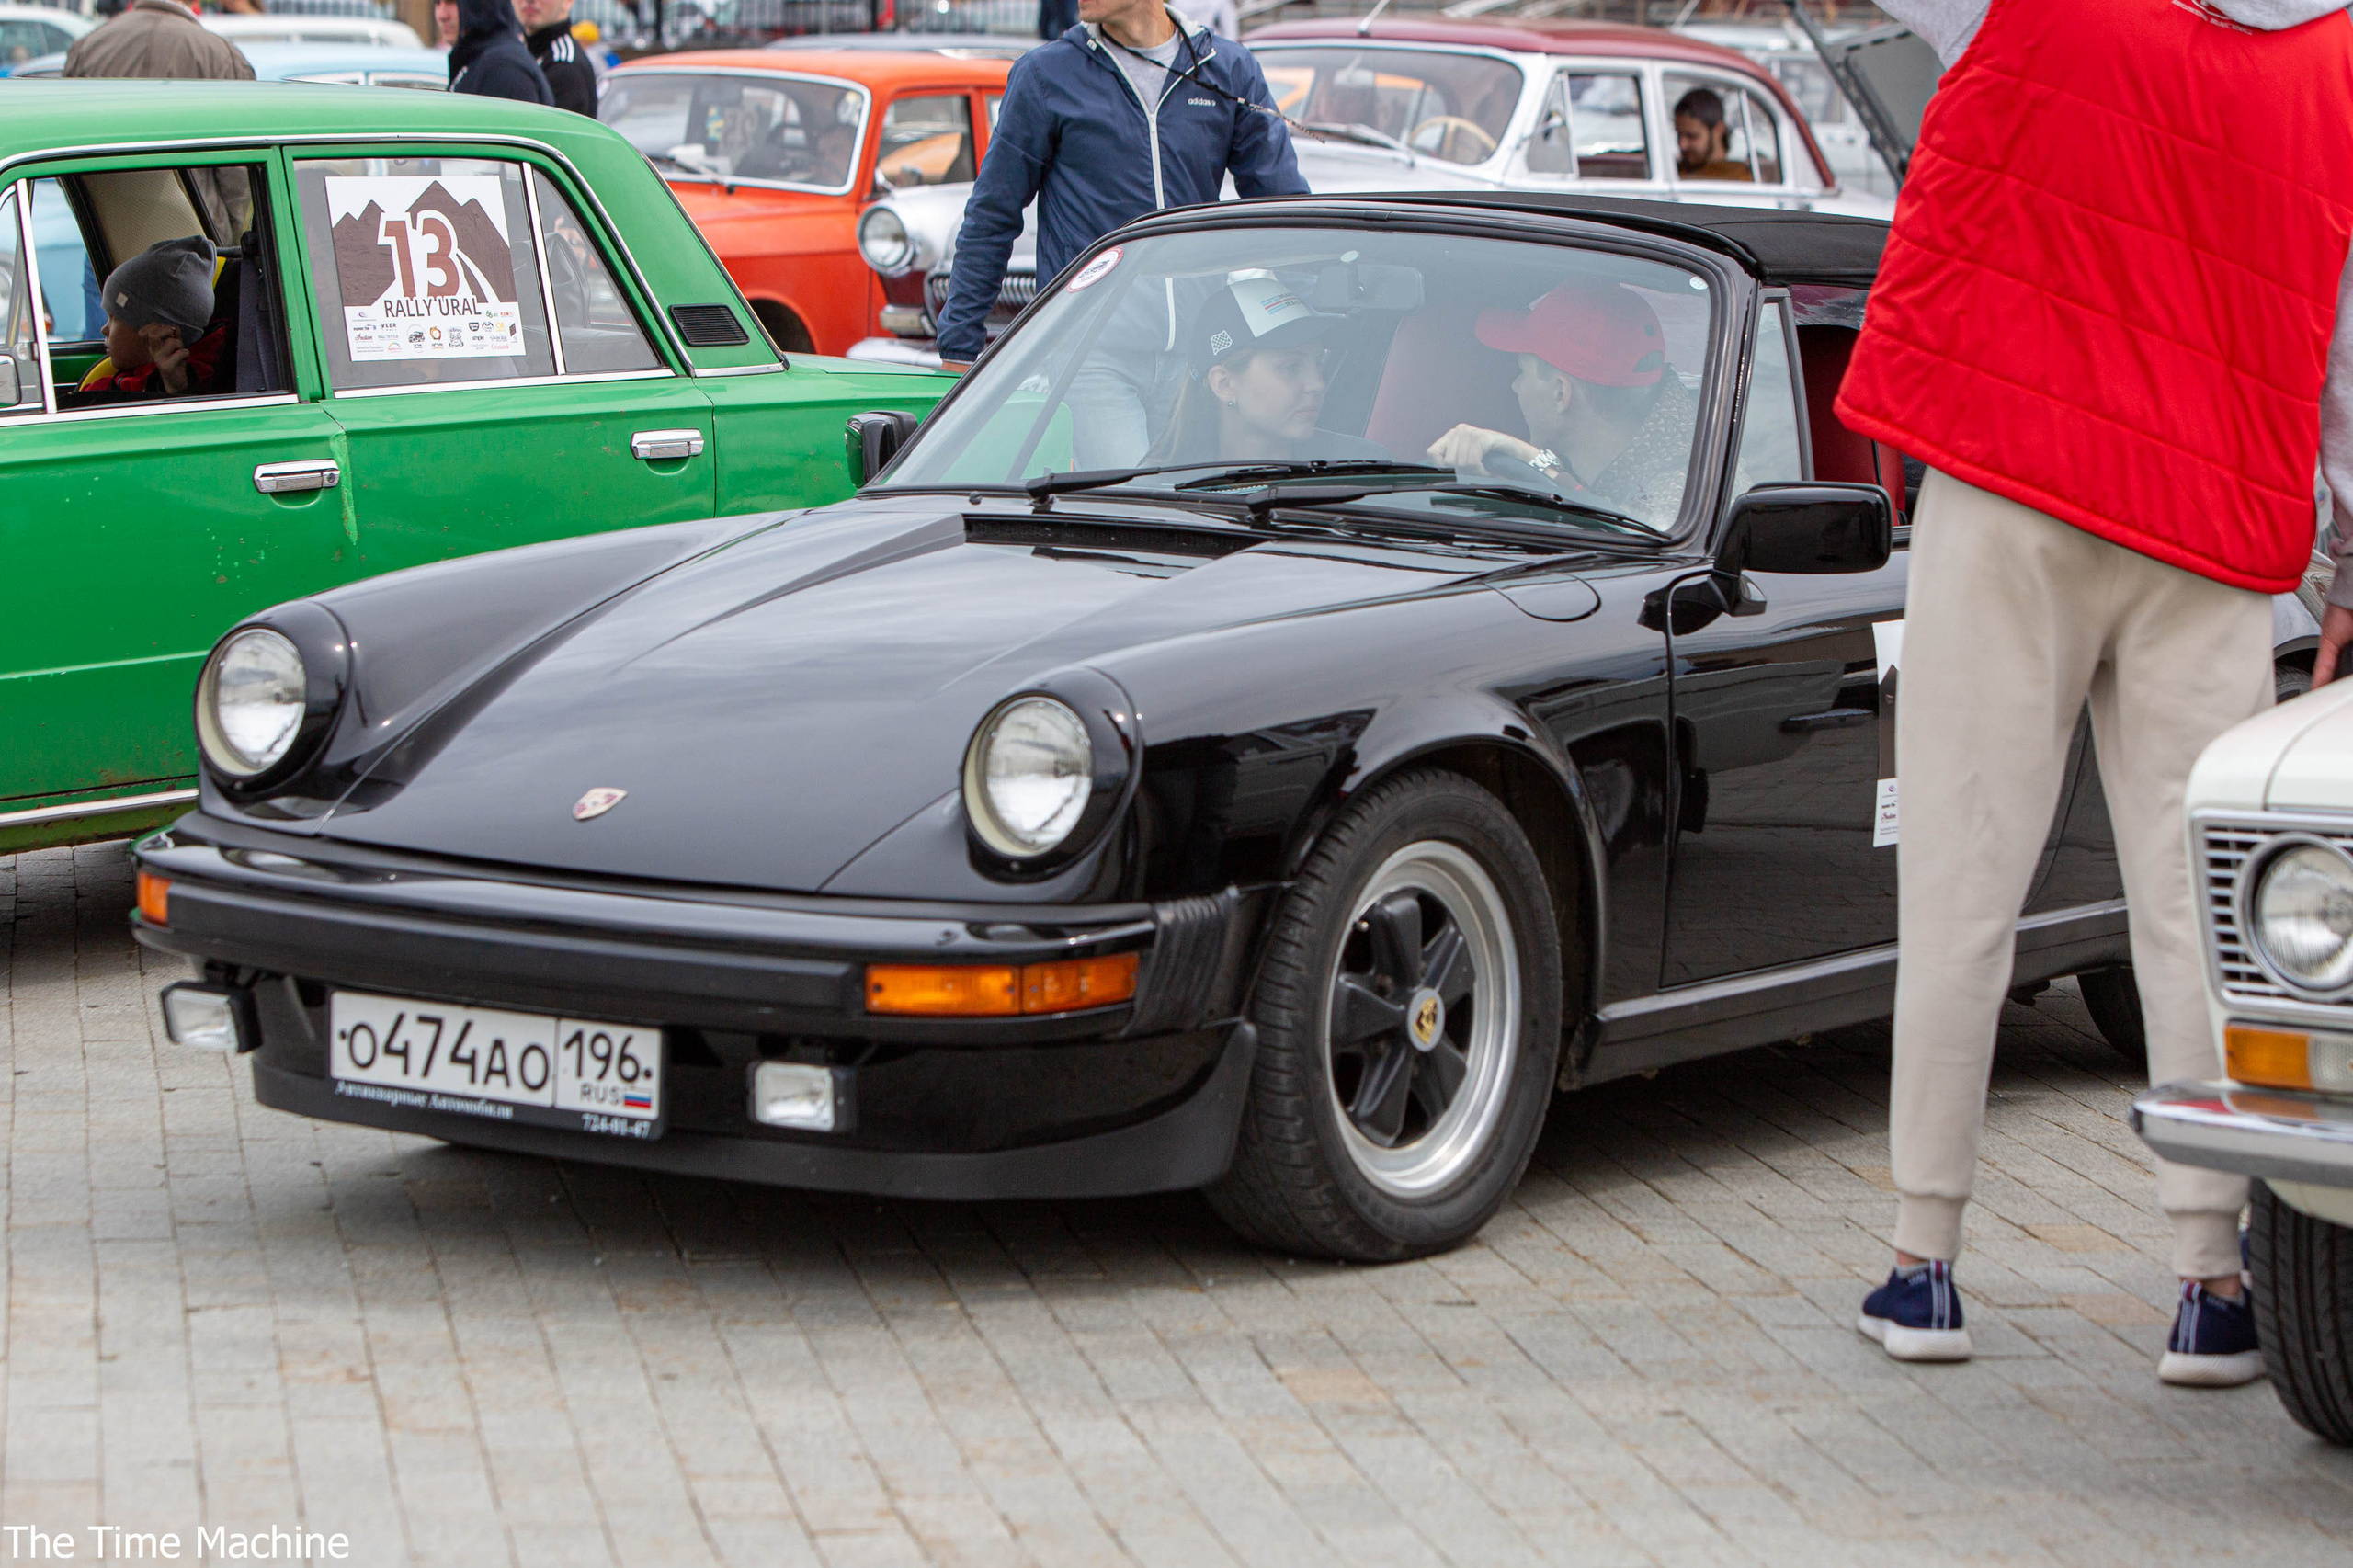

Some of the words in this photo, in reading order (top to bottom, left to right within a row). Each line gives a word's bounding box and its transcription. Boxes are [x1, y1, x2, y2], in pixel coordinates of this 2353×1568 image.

[1188, 97, 1211, 106] adidas
[384, 218, 460, 299] 13
[384, 299, 433, 318] RALLY
[438, 298, 482, 317] URAL
[563, 1028, 641, 1083] 196
[580, 1084, 620, 1106] RUS
